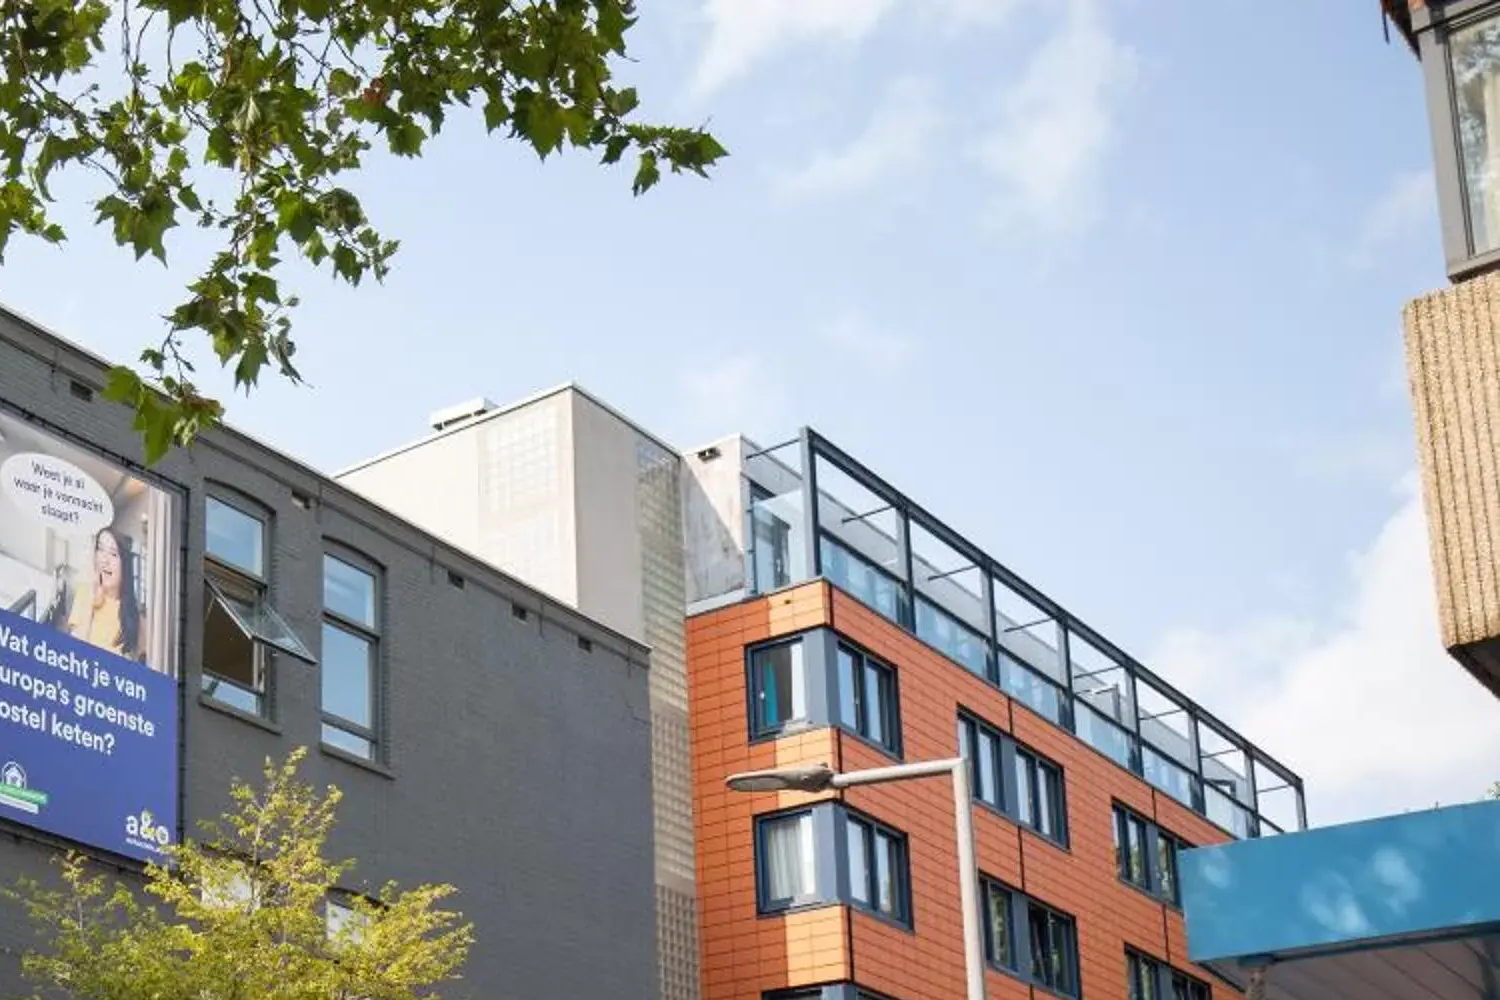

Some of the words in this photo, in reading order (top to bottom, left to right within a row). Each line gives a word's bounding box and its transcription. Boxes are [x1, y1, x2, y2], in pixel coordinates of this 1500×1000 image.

[13, 476, 41, 493] waar
[33, 641, 89, 679] dacht
[91, 661, 111, 689] je
[114, 675, 147, 701] van
[51, 712, 116, 755] keten?
[73, 694, 156, 737] groenste
